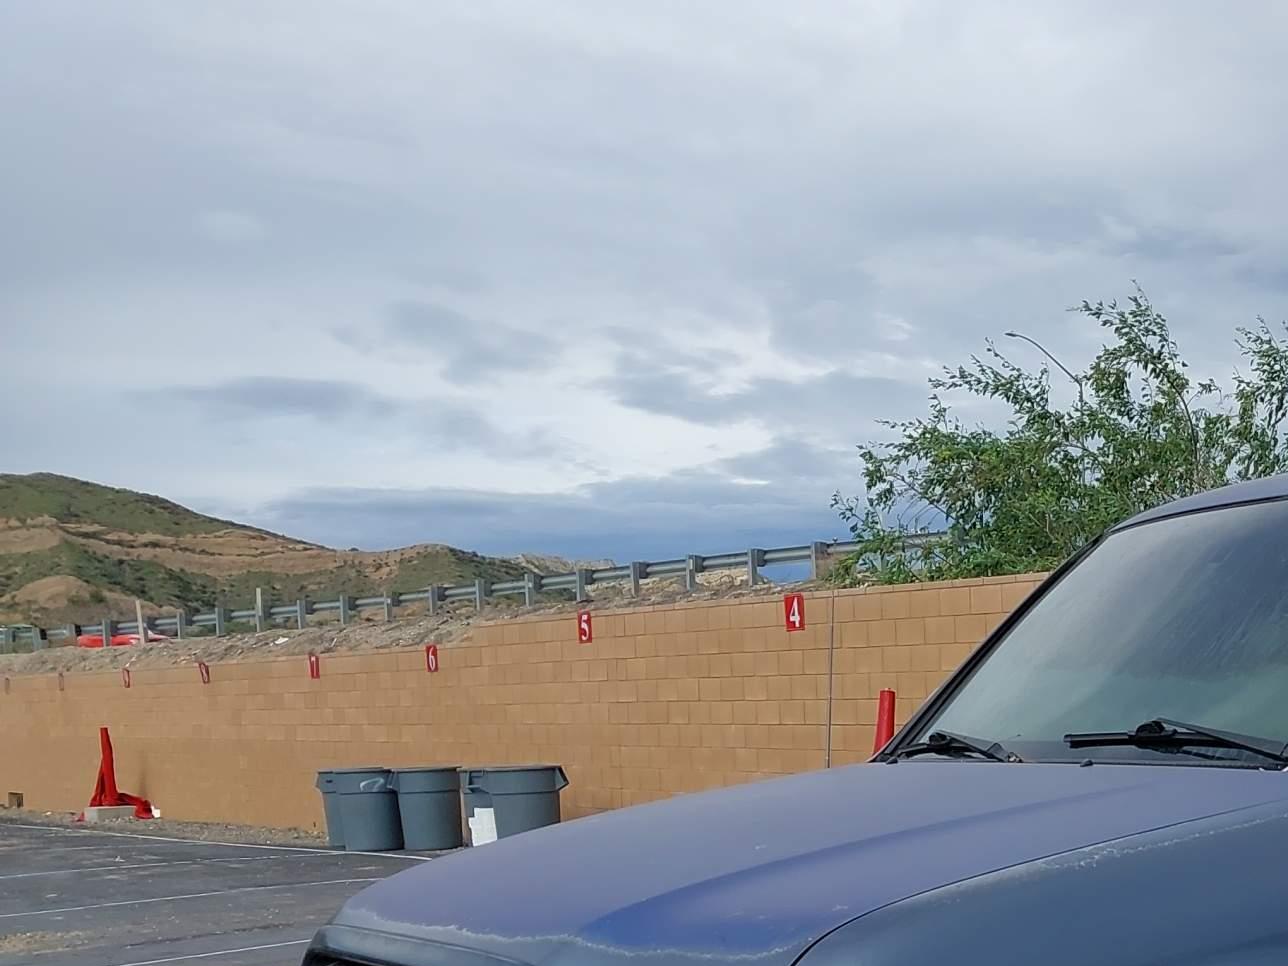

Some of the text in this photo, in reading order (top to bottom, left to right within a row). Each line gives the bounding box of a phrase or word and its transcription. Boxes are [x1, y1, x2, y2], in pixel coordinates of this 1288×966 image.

[790, 597, 800, 627] 4
[581, 614, 589, 640] 5
[429, 646, 435, 671] 6
